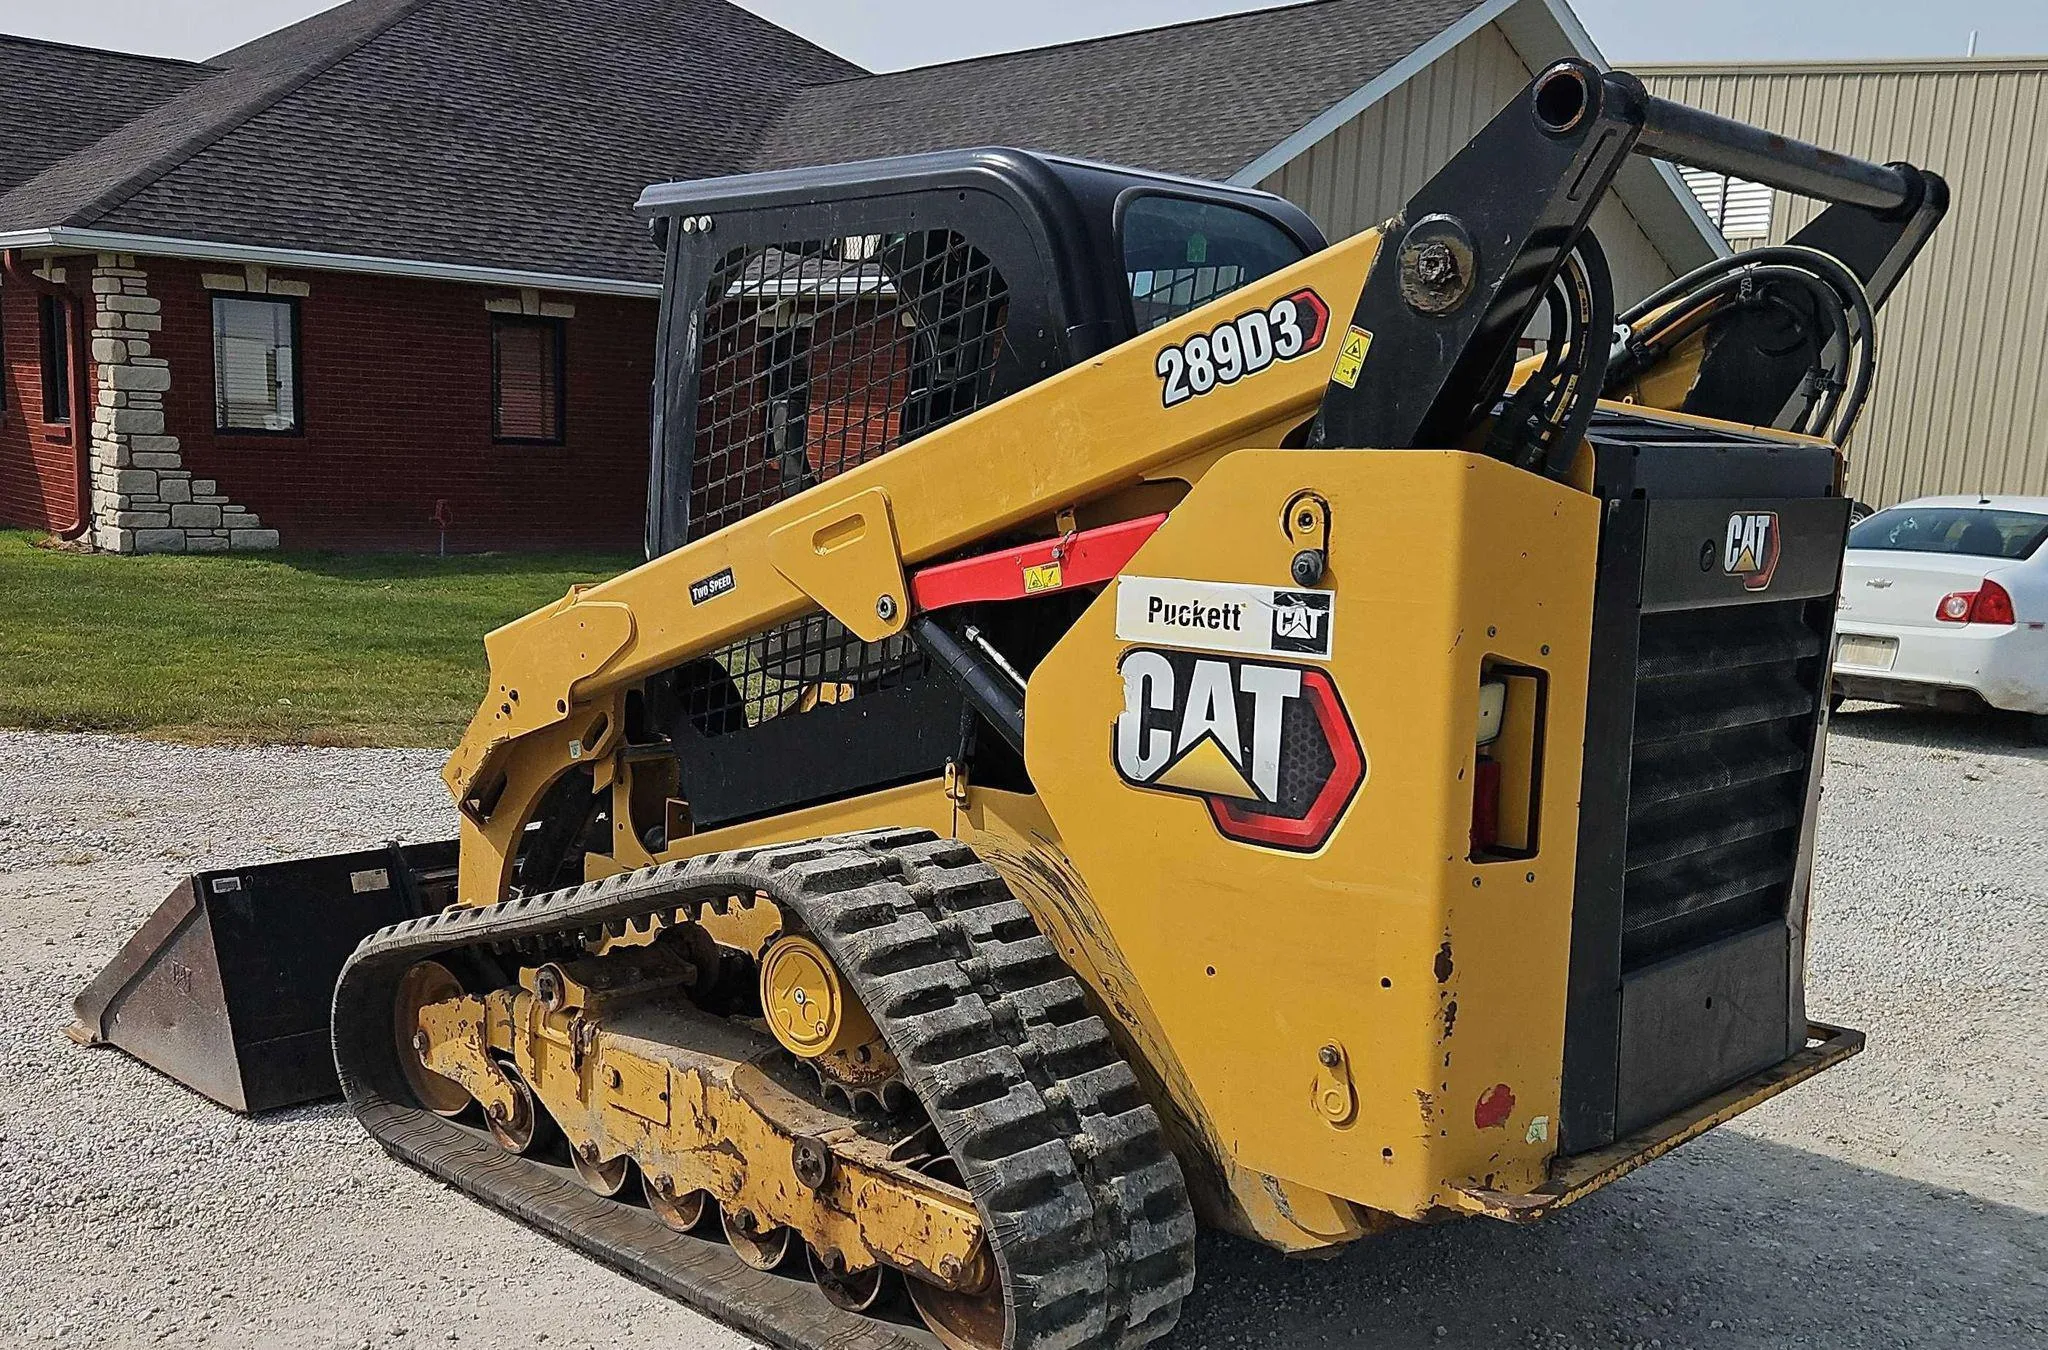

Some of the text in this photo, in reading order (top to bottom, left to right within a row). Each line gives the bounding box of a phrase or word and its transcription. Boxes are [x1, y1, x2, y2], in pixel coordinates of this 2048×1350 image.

[1158, 300, 1303, 404] 289D3
[1724, 514, 1770, 572] CAT
[1148, 596, 1329, 639] Puckett CAT
[1118, 651, 1301, 803] CAT
